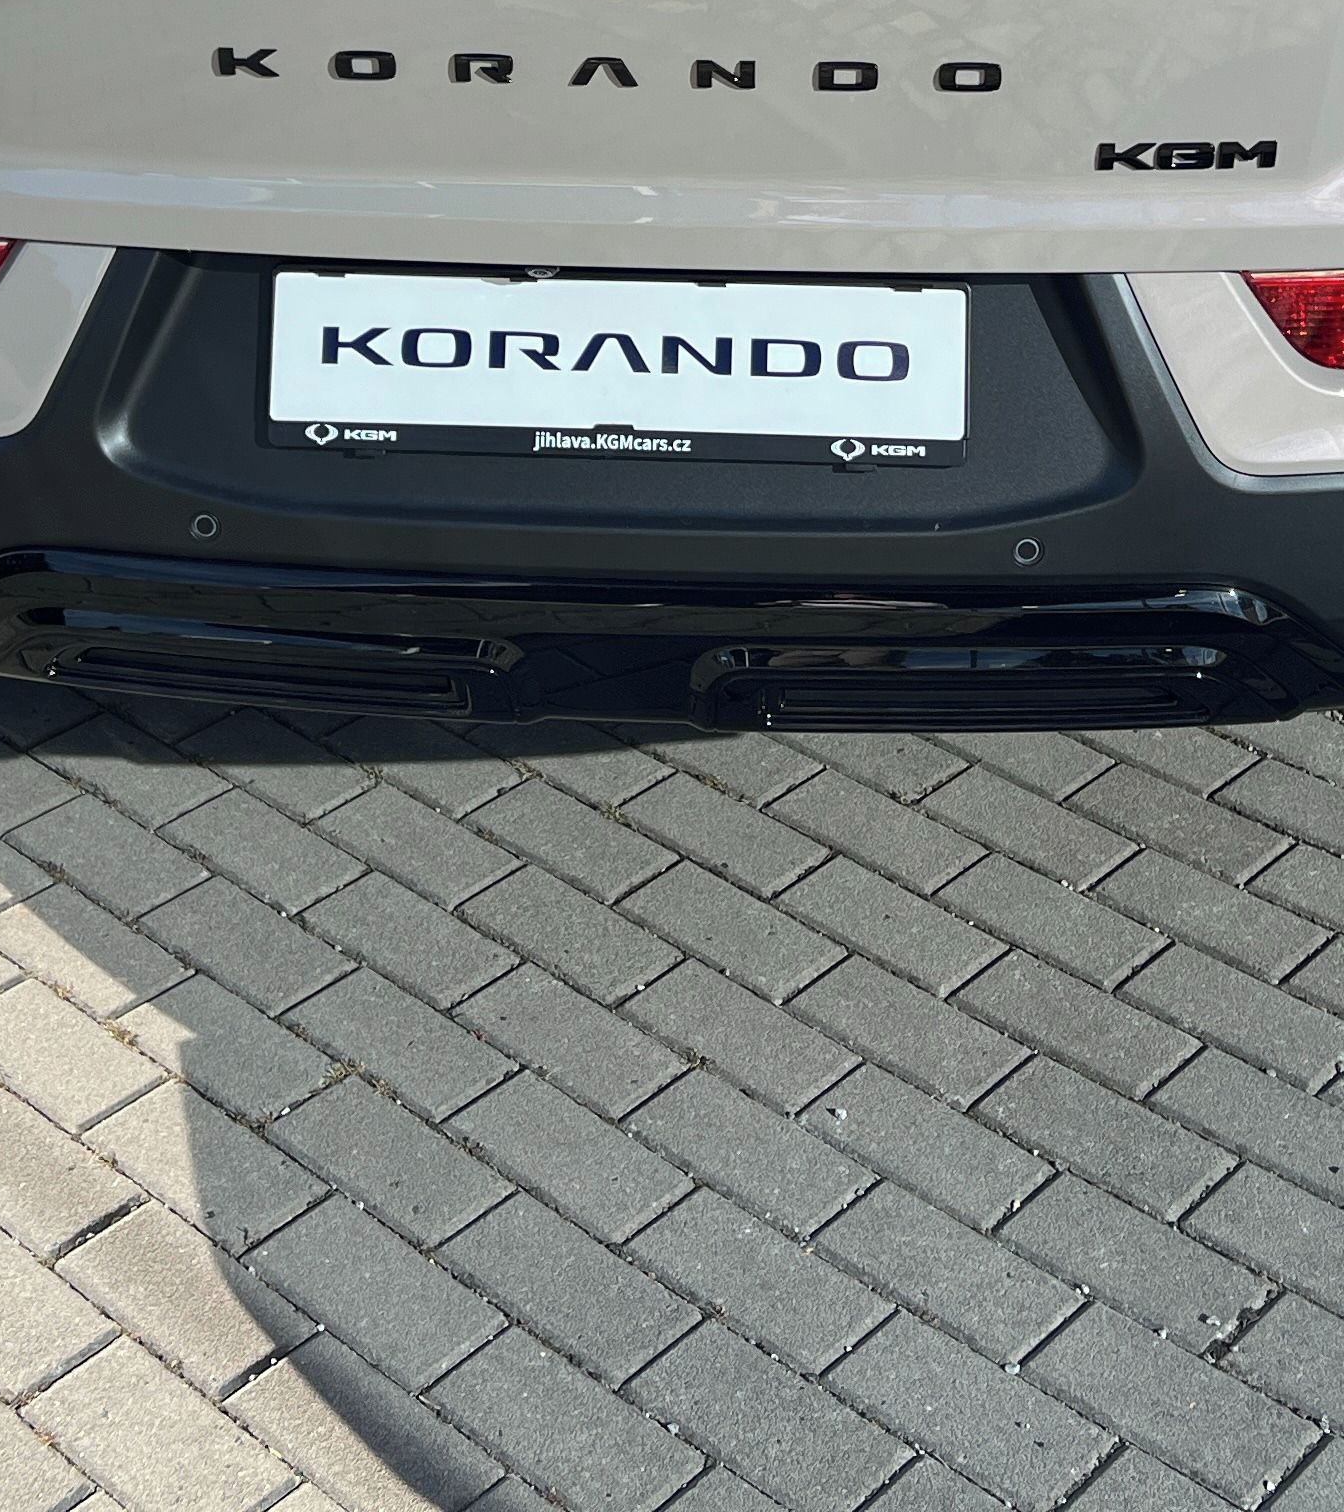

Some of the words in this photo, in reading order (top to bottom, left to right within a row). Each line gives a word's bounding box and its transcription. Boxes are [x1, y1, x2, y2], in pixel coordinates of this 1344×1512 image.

[214, 46, 1002, 93] KORANDO
[1094, 140, 1278, 171] KGM
[321, 326, 910, 382] KORANDO
[343, 429, 397, 442] KGM
[532, 431, 692, 452] jihlava.KGMcars.cz
[871, 444, 926, 457] KGM
